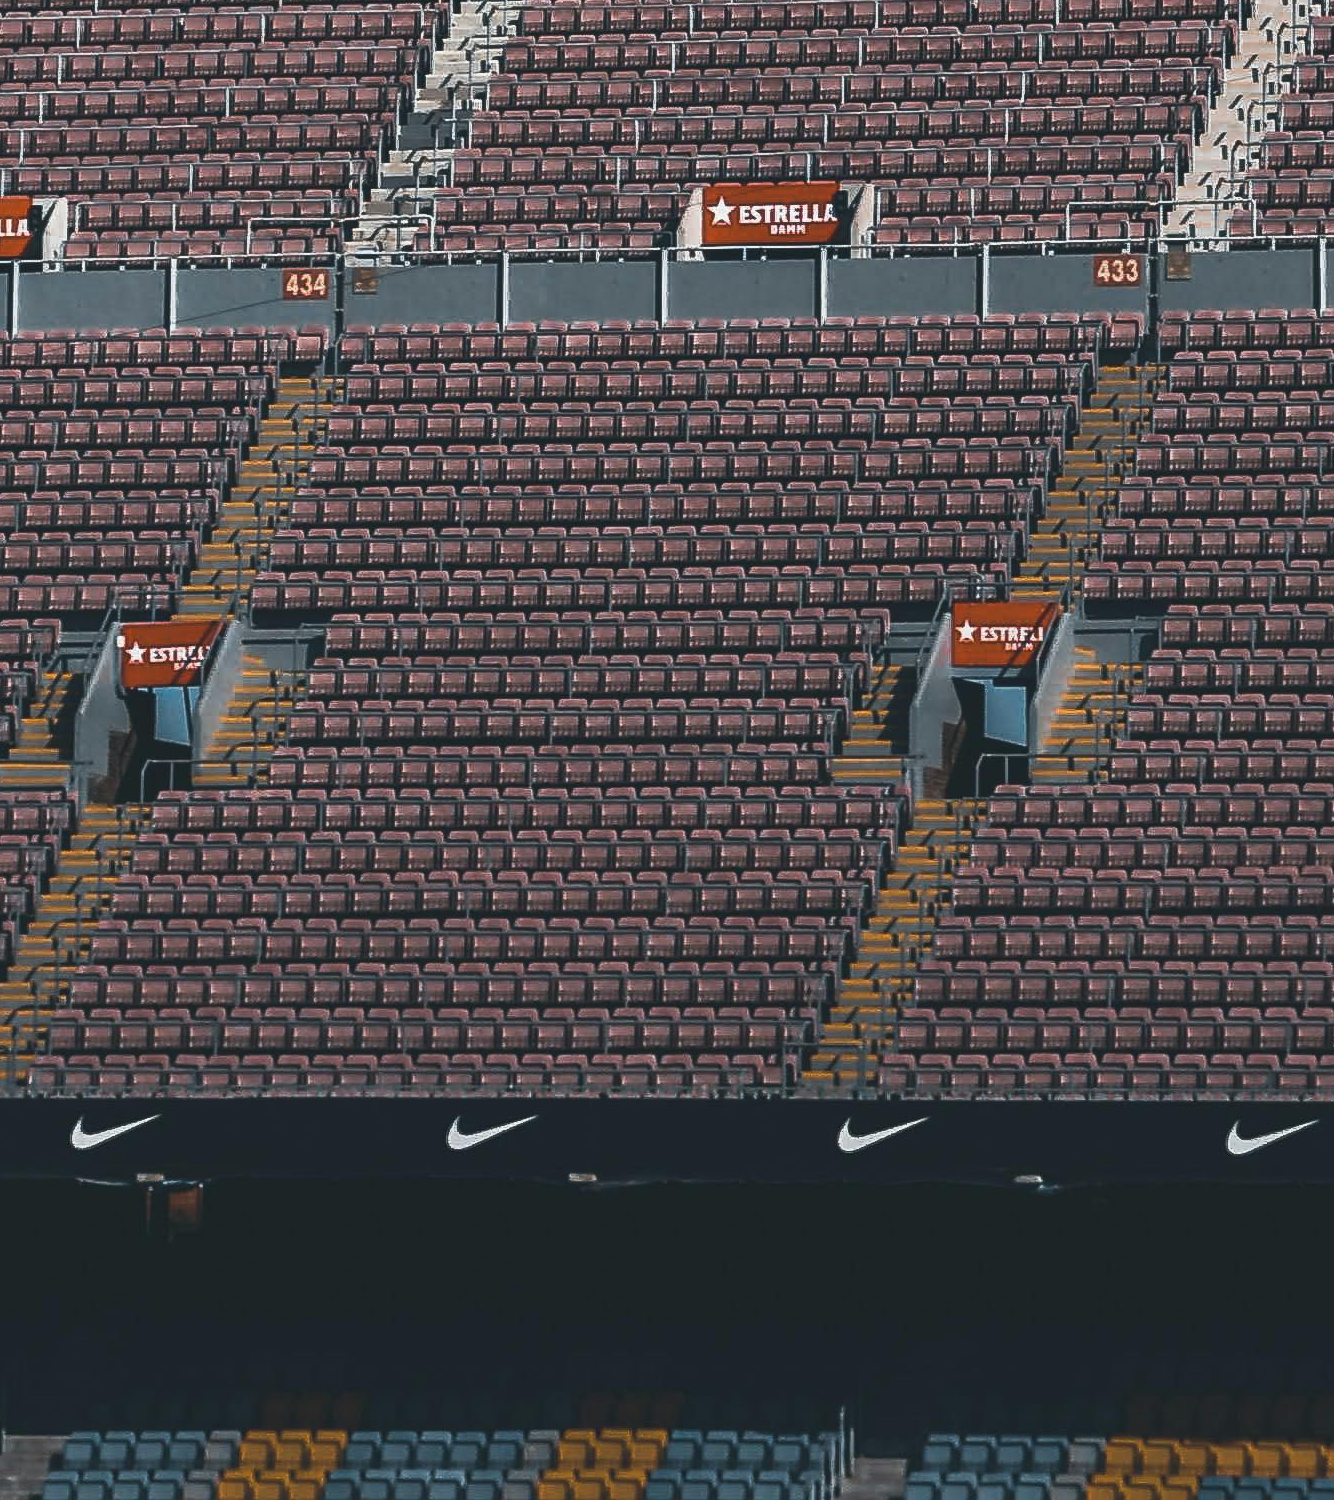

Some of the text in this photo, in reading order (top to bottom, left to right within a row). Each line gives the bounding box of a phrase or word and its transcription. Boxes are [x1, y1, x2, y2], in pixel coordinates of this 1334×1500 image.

[738, 203, 838, 224] ESTRELLA
[770, 224, 806, 235] DAMM
[1097, 258, 1140, 283] 433
[285, 272, 327, 297] 434
